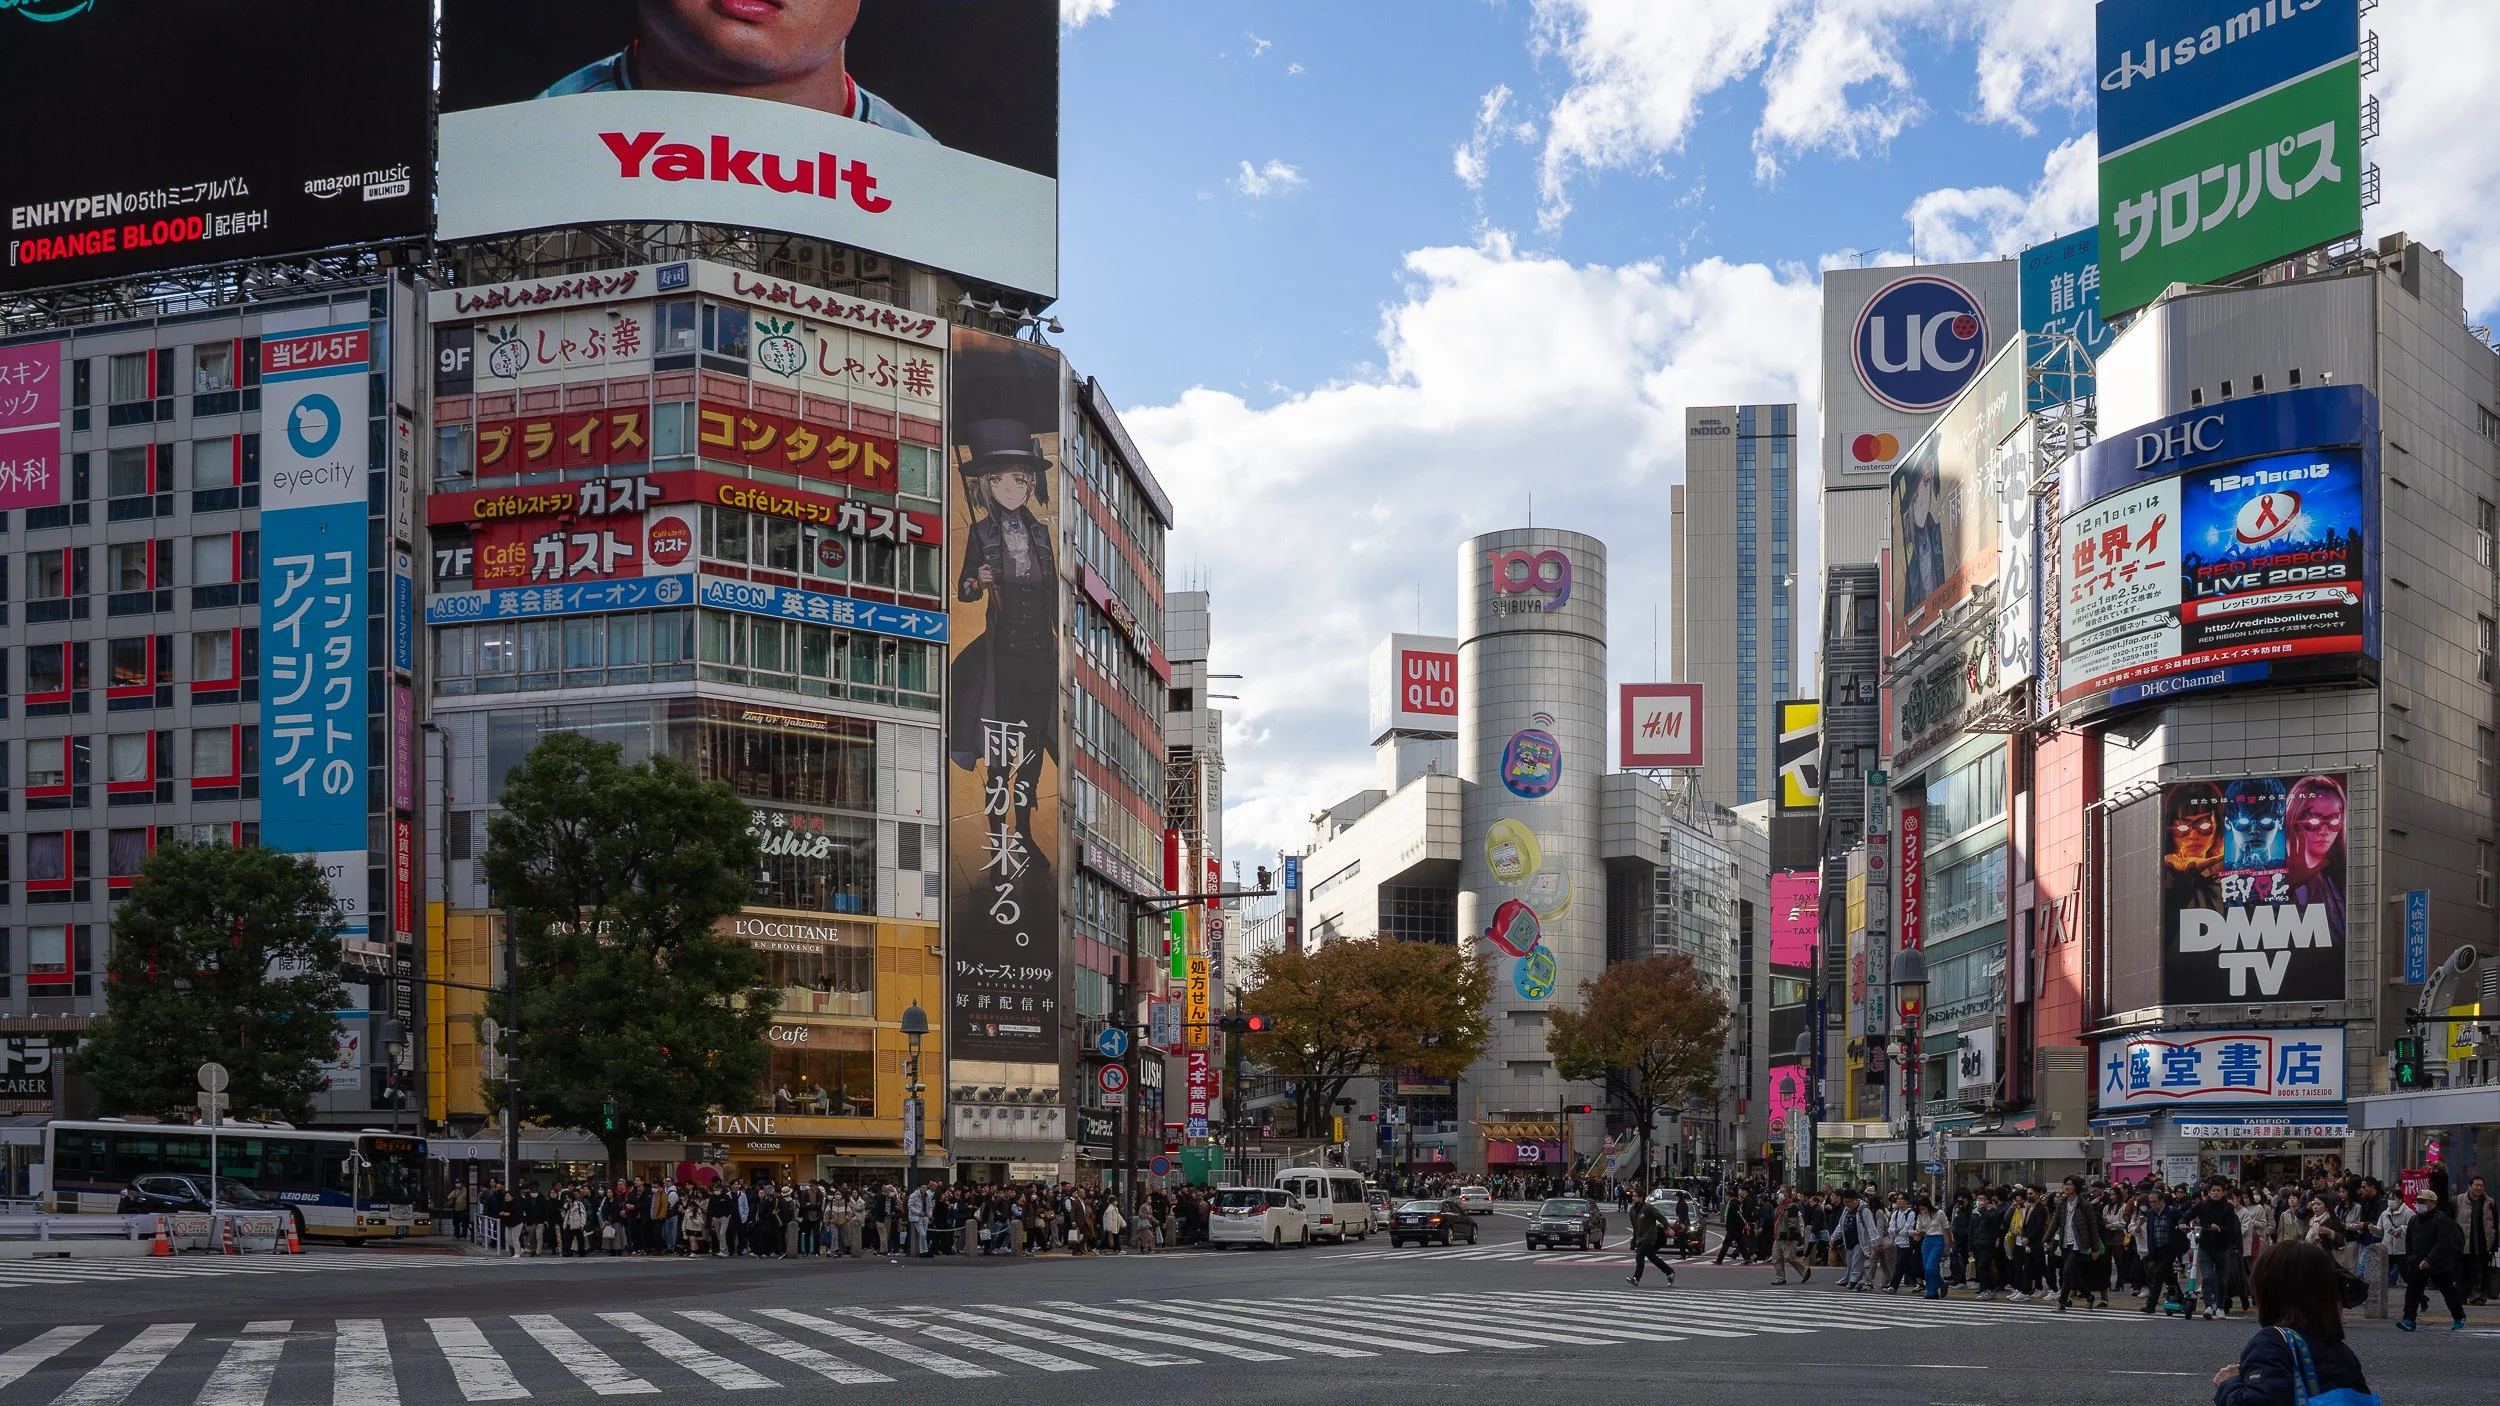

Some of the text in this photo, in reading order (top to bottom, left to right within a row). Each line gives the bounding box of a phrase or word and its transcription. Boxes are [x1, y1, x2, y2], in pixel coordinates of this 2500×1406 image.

[304, 163, 411, 195] amazon music
[599, 132, 892, 214] Yakult
[11, 177, 249, 230] ENHYPENの5thミニアルバム
[368, 183, 406, 198] UNLIMITED
[2114, 120, 2341, 262] サロンパス
[9, 226, 115, 266] 『ORANGE
[455, 270, 639, 313] しゃぶしゃぶバイキング
[658, 266, 686, 287] 寿司
[734, 271, 936, 338] しゃぶしゃぶバイキング
[273, 336, 357, 367] 当ビル5F
[441, 318, 641, 372] 9F しゃぶ葉
[819, 337, 934, 397] しゃぶ葉
[0, 390, 39, 417] ック
[480, 413, 645, 465] プライス
[701, 410, 890, 477] コンタクト
[1690, 426, 1730, 436] INDIGO
[2134, 414, 2224, 470] DHC
[274, 461, 354, 493] eyecity
[474, 477, 660, 518] Caféレストラン ガスト
[719, 485, 922, 543] Caféレストラン ガスト
[436, 531, 632, 581] 7F Café ガスト
[654, 539, 687, 553] ガスト
[2198, 550, 2346, 578] RED RIBBON
[658, 581, 677, 598] 6F
[709, 582, 766, 608] AEON
[1488, 549, 1571, 611] 109
[2070, 560, 2165, 604] エイズデー
[2198, 565, 2345, 596] LIVE 2023
[436, 597, 482, 616] AEON
[1493, 599, 1542, 613] SHIBUYA
[2222, 591, 2316, 610] レッドリボンライブ
[2205, 611, 2340, 633] http://redribbonlive.net
[2216, 631, 2247, 640] RIBBON
[273, 554, 316, 796] アイシティ
[322, 551, 354, 795] コンタクトの
[1409, 658, 1451, 681] UNI
[2141, 671, 2225, 697] DHC Channel
[1409, 685, 1454, 707] QLO
[1642, 711, 1682, 739] H&M
[752, 810, 787, 828] 渋谷
[980, 717, 1036, 947] 雨が来る。
[735, 919, 839, 942] L'OCCITANE
[2179, 903, 2332, 952] DMM
[2410, 896, 2424, 980] 大盛堂商事ビル
[771, 942, 821, 952] PROVENCE
[2218, 951, 2292, 996] TV
[956, 994, 1054, 1012] 好評配信中
[1191, 960, 1206, 1019] 処方せん
[769, 1025, 808, 1045] Café
[1140, 1059, 1162, 1088] LUSH
[2106, 1041, 2323, 1094] 大盛堂書店
[1190, 1053, 1207, 1114] スギ薬局
[2277, 1088, 2333, 1097] BOOKS TAISEIDO
[1189, 1128, 1208, 1137] 営業
[1517, 1145, 1539, 1161] 109
[280, 1192, 320, 1201] KEIO BUS
